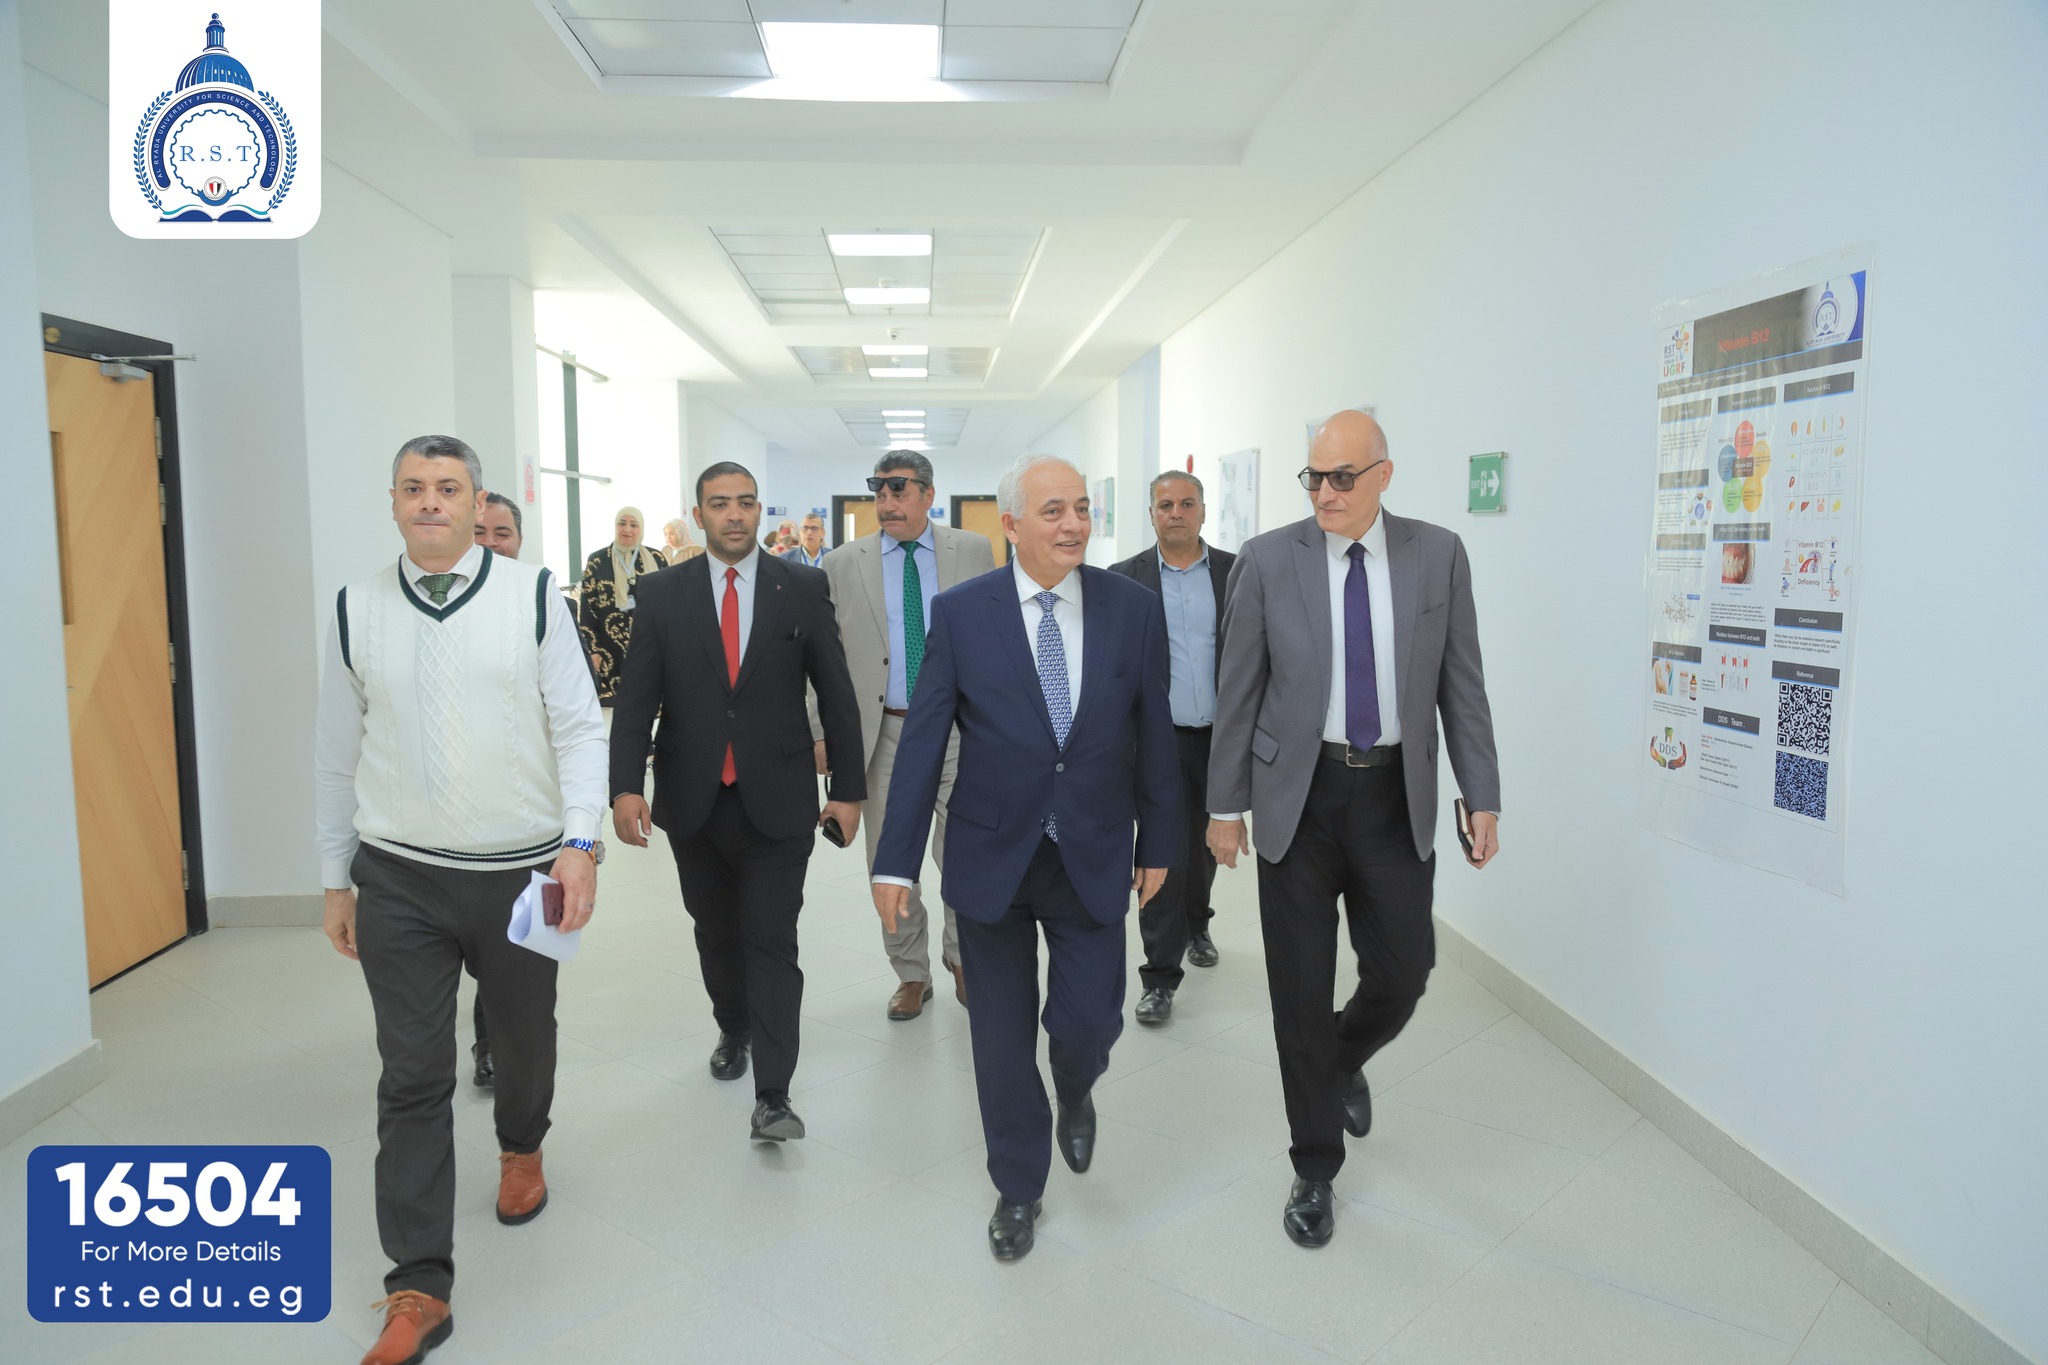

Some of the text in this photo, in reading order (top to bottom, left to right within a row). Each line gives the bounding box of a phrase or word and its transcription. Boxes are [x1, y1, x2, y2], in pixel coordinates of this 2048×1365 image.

[1751, 327, 1771, 345] B12
[1664, 344, 1675, 355] RST
[1663, 362, 1685, 378] UGRF
[1798, 578, 1820, 587] Deficiency
[1798, 616, 1818, 625] Conclusion
[1796, 670, 1814, 679] Reference
[1717, 715, 1743, 728] DDS Team
[1659, 742, 1677, 757] DDS
